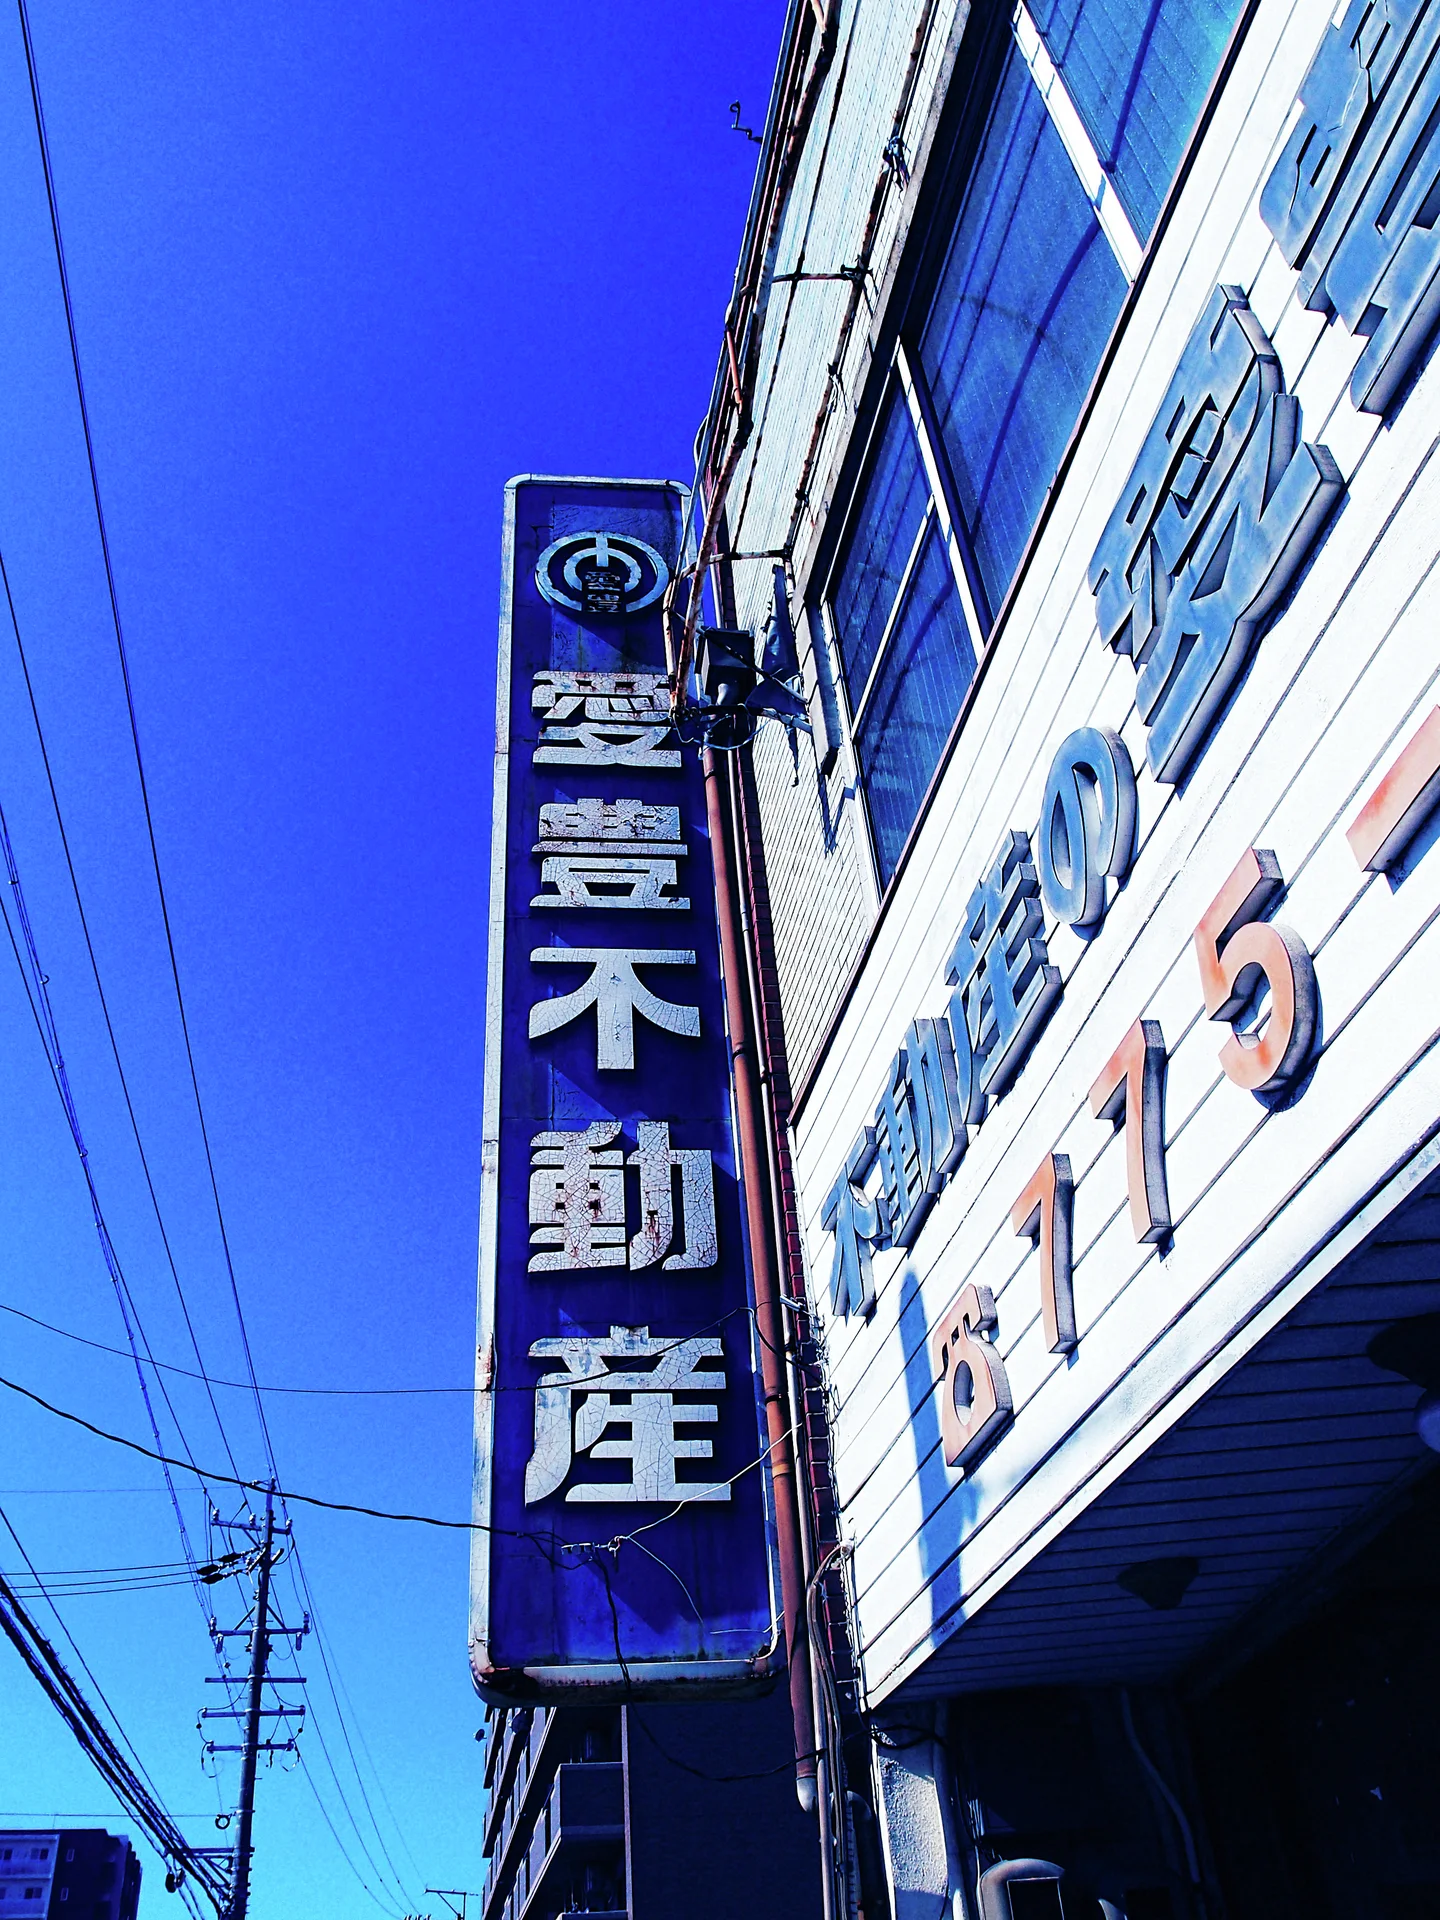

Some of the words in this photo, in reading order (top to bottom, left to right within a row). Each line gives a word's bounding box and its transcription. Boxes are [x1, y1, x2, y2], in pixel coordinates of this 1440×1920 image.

[524, 670, 732, 1507] 愛豊不動産
